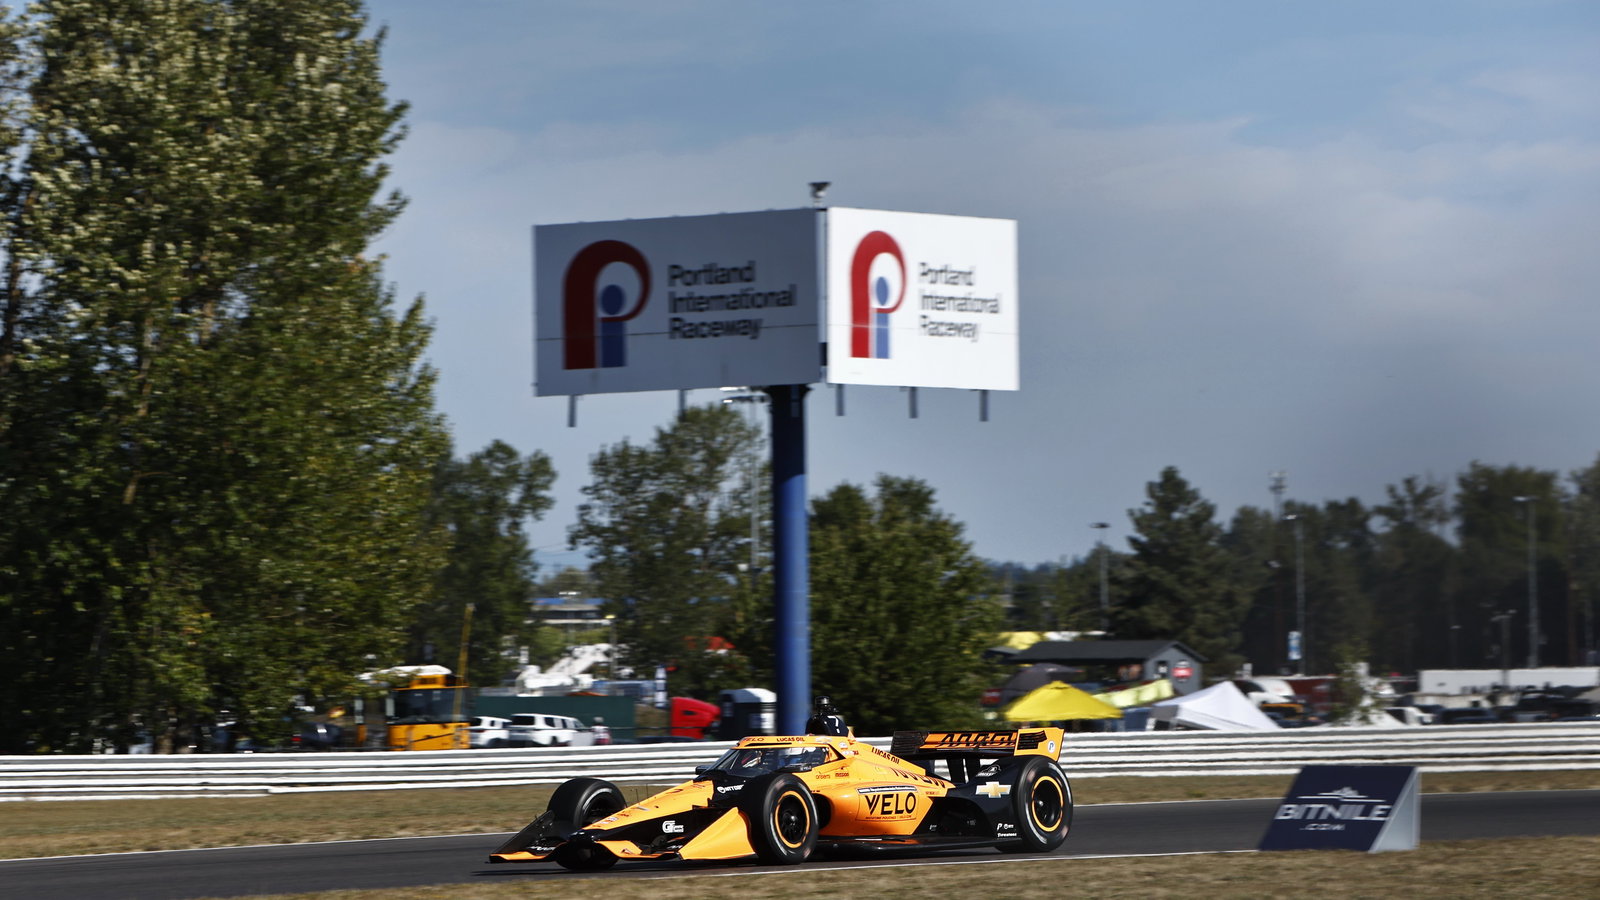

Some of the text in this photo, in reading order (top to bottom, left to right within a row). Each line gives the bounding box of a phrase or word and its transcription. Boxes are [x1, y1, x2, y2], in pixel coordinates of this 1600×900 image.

[668, 260, 756, 287] Portland
[919, 261, 976, 286] Portland
[668, 284, 797, 313] International
[919, 289, 1002, 314] International
[668, 317, 762, 340] Raceway
[919, 314, 980, 342] Raceway
[871, 746, 892, 761] LUCAS
[890, 756, 900, 764] OIL
[864, 792, 917, 815] VELO
[1273, 804, 1393, 821] BITNILE
